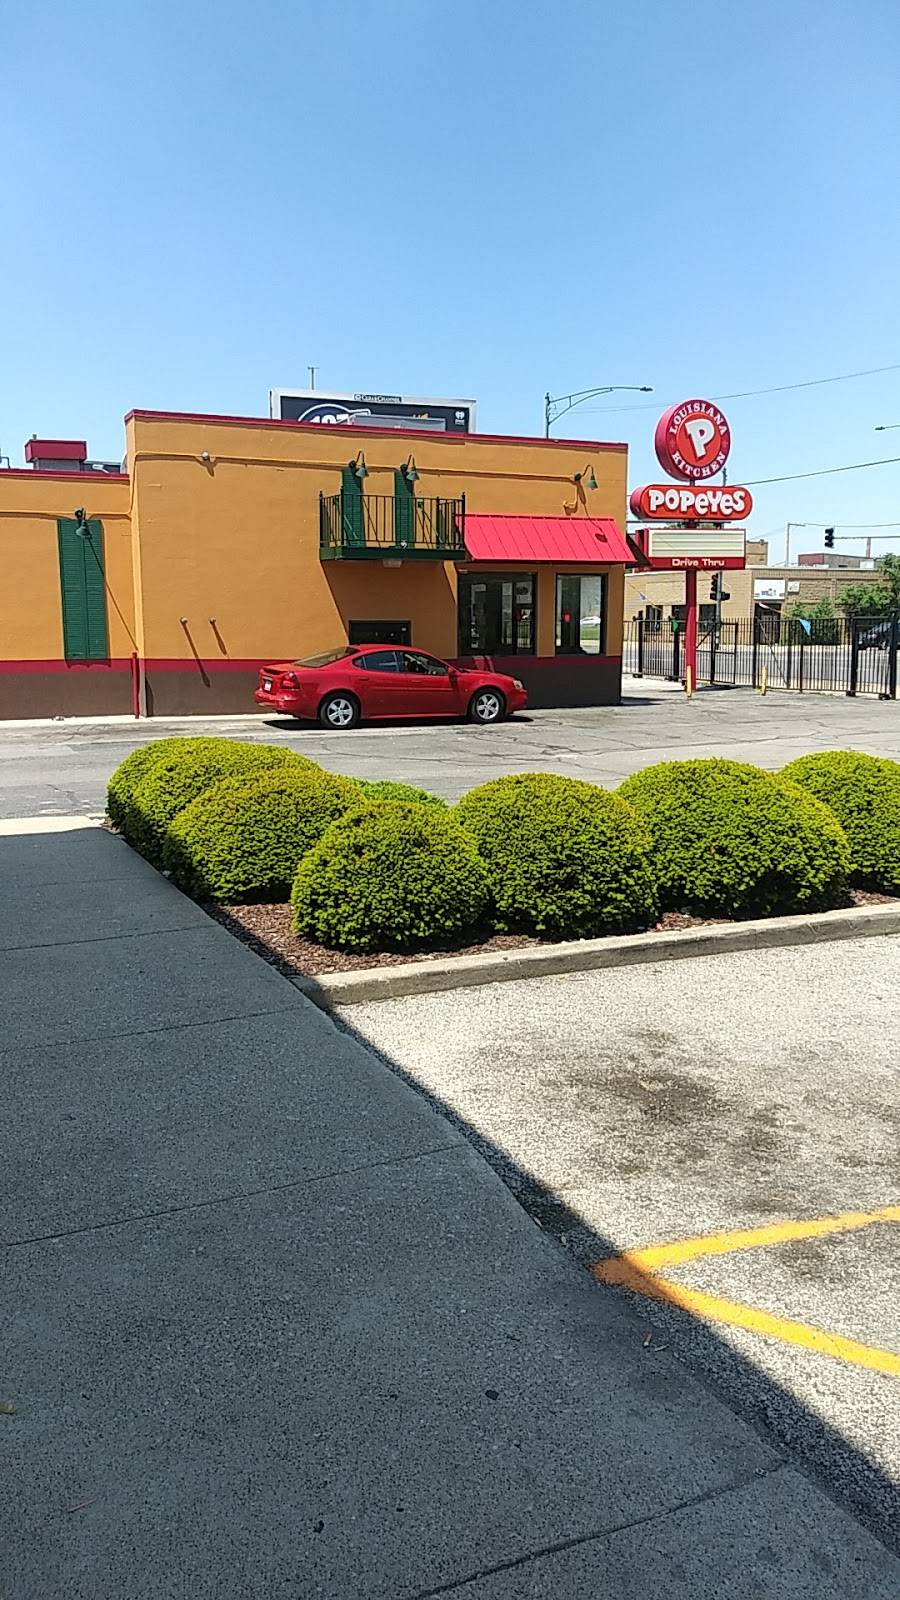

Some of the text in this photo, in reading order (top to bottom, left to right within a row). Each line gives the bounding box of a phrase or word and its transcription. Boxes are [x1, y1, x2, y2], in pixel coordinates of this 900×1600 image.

[669, 402, 728, 435] LOUISIANA
[684, 418, 716, 459] P
[671, 450, 726, 478] KITCHEN
[672, 558, 725, 567] Drive Thru
